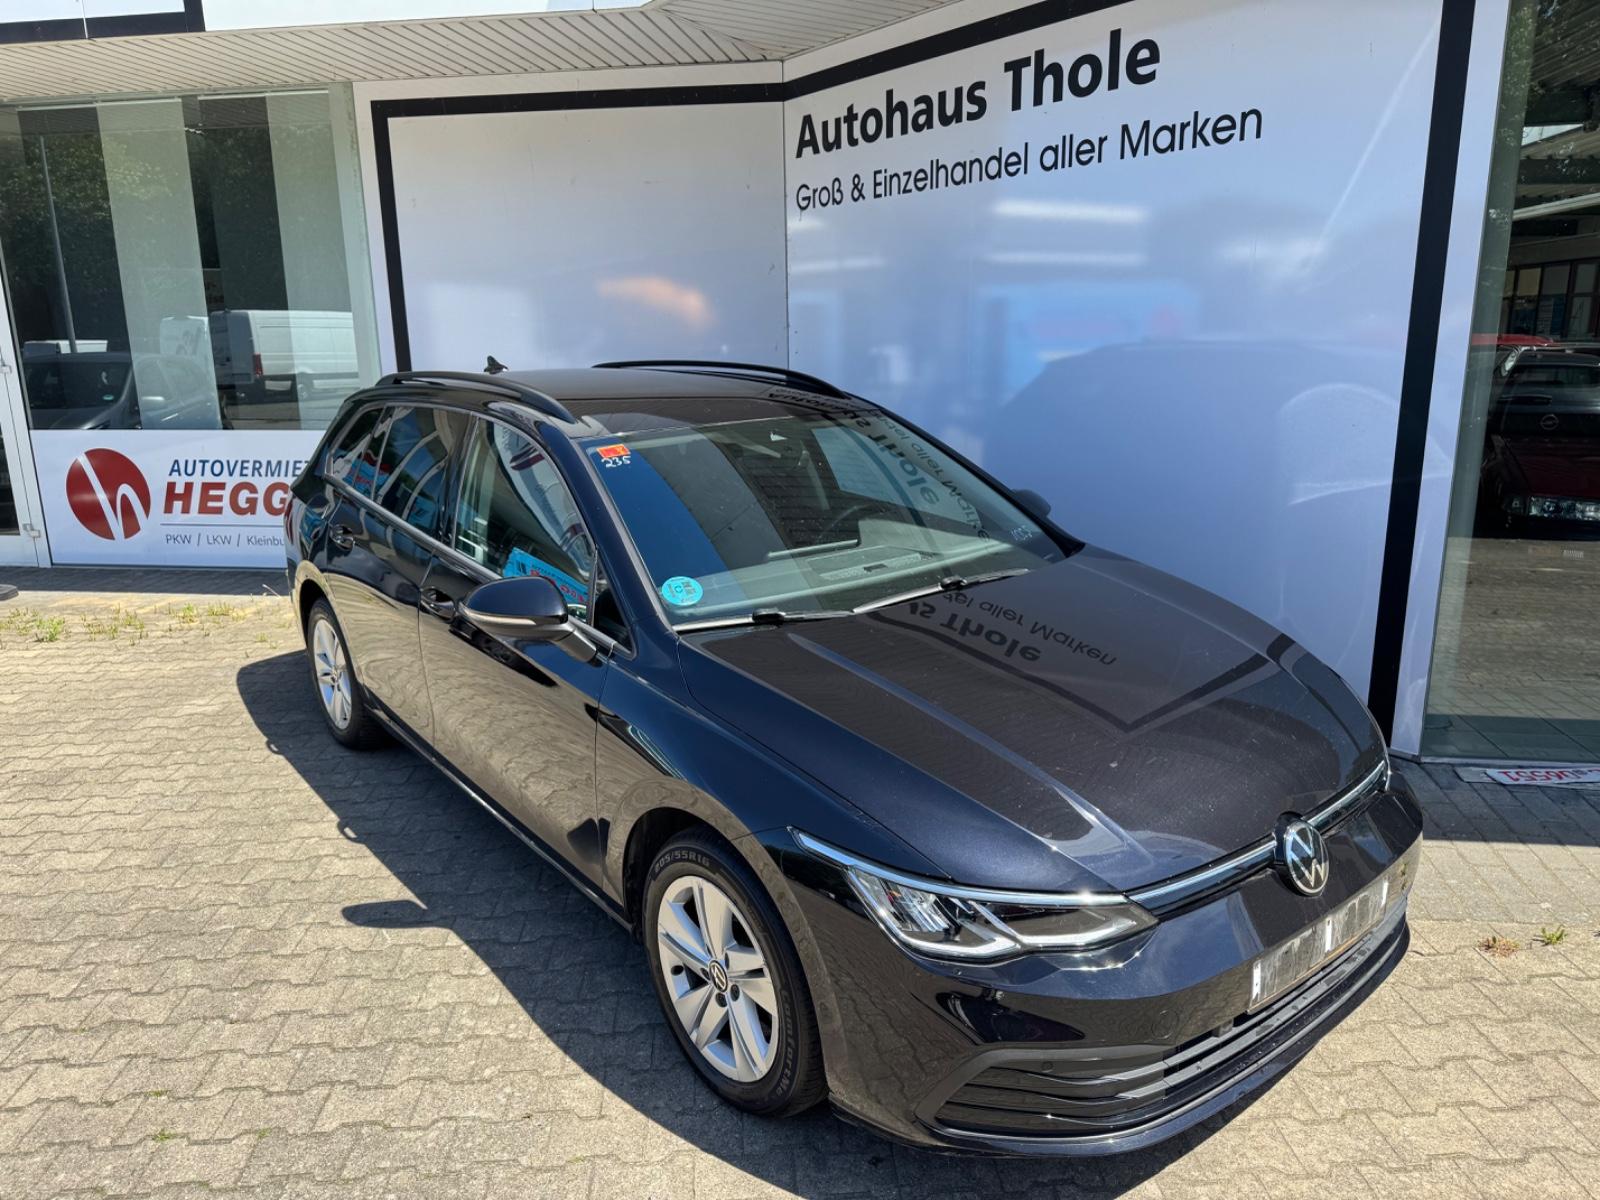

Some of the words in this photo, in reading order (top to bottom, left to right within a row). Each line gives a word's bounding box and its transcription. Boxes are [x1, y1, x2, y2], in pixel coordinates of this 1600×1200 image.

[795, 80, 987, 158] Autohaus
[1004, 28, 1160, 112] Thole
[796, 178, 844, 211] Groß
[851, 174, 866, 201] &
[873, 143, 1028, 199] Einzelhandel
[1040, 133, 1108, 172] aller
[1120, 107, 1263, 161] Marken
[168, 459, 310, 477] AUTOVERMIE
[163, 481, 290, 517] HEGG
[166, 534, 192, 545] PKW
[206, 534, 232, 545] LKW
